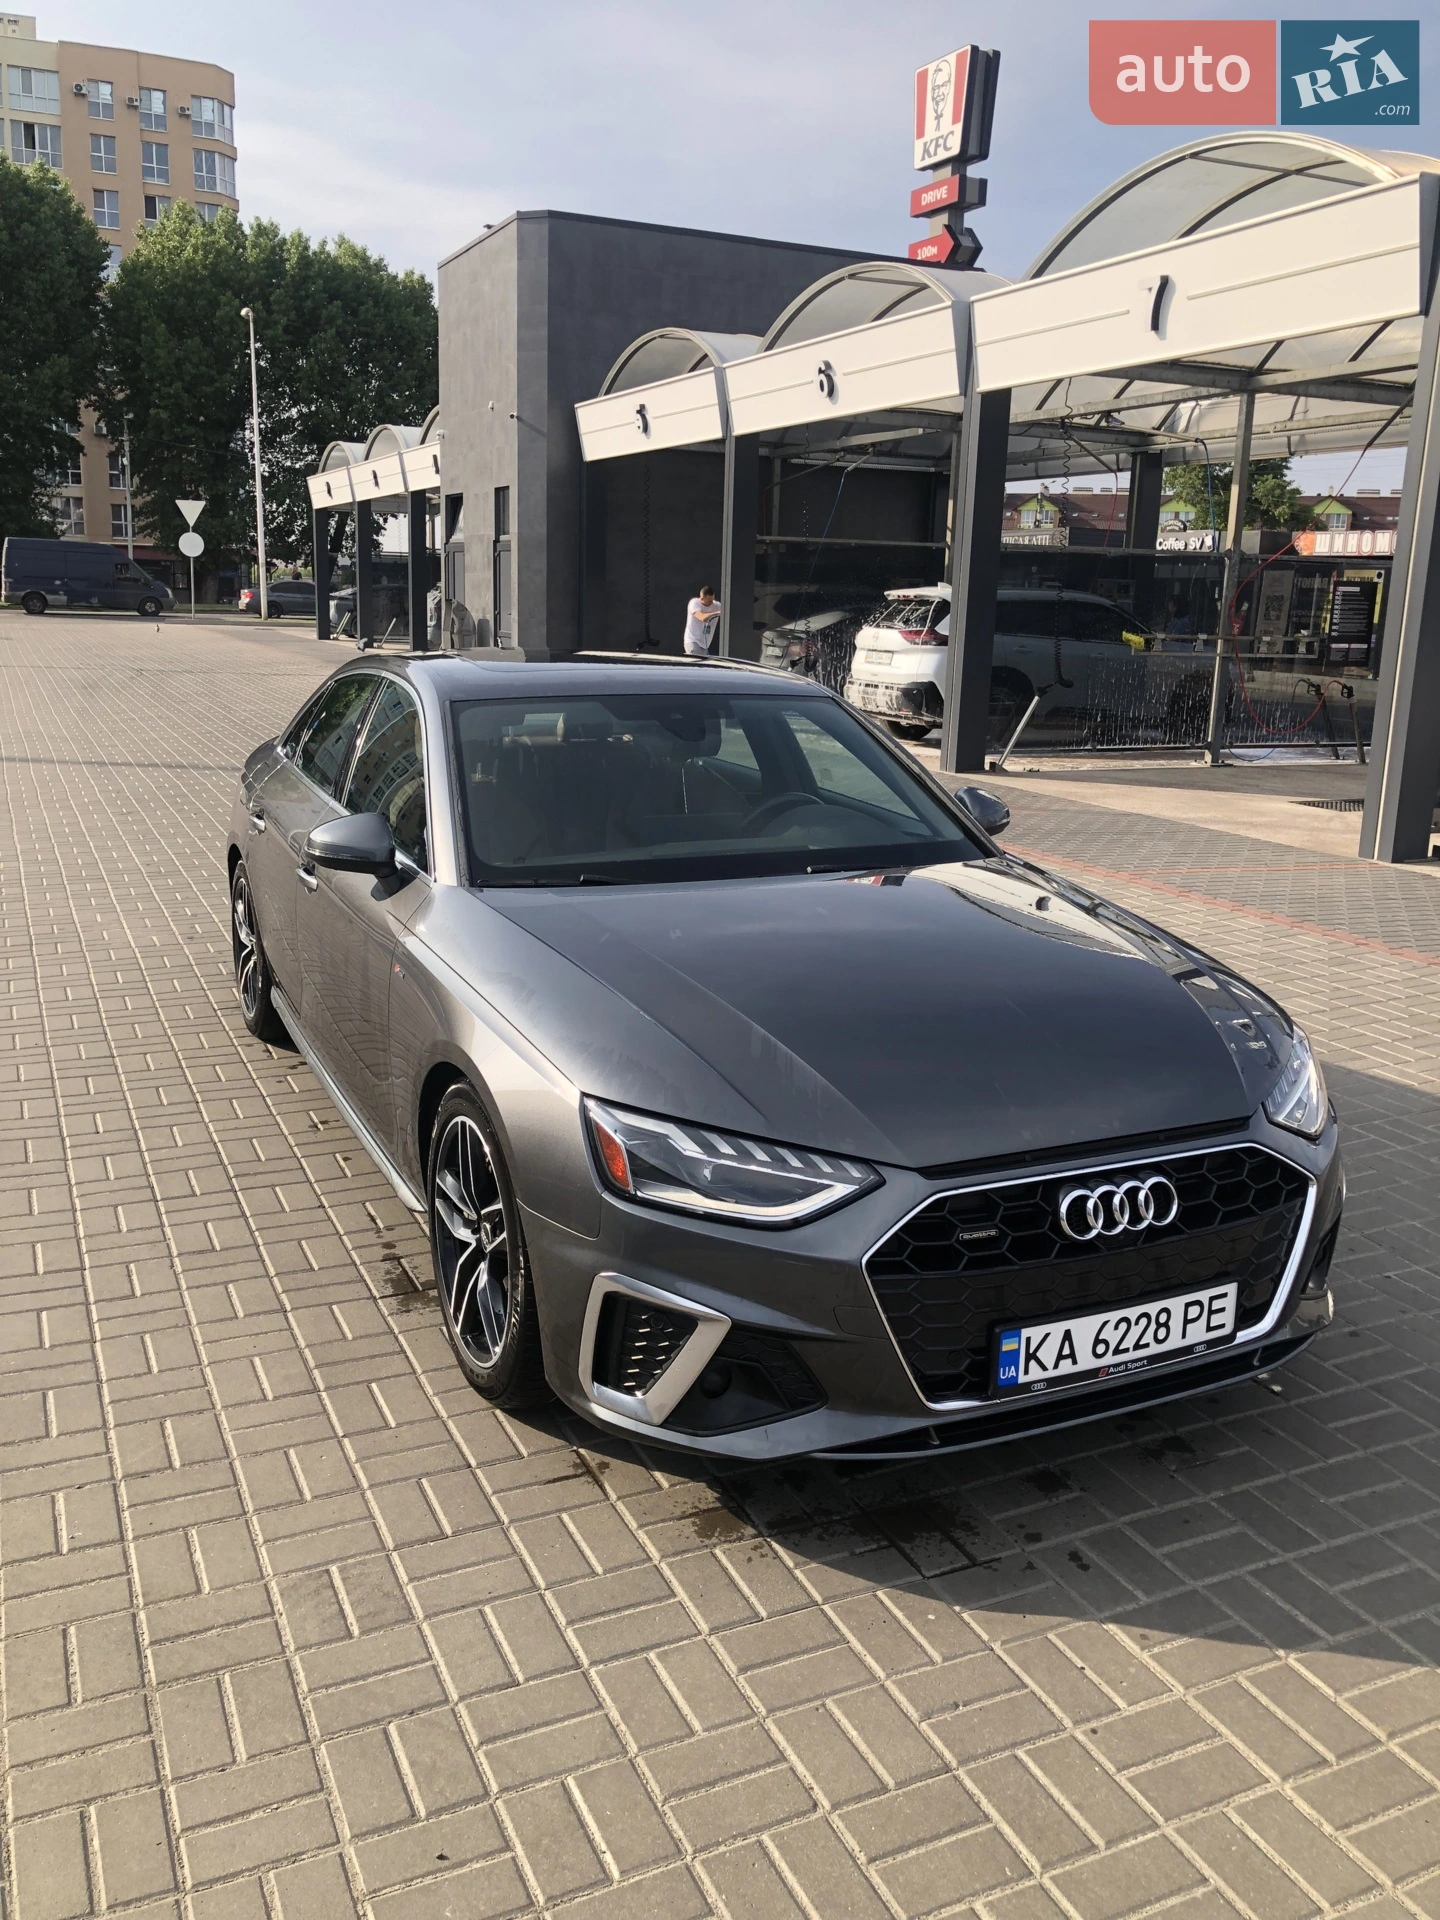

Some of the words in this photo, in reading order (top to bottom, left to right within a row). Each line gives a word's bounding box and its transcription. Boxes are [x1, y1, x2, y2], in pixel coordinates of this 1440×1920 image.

[920, 130, 954, 162] KFC
[921, 185, 949, 206] DRIVE
[1138, 274, 1169, 332] 7
[816, 359, 835, 399] 6
[1156, 537, 1186, 551] Coffee
[1188, 537, 1203, 550] SV
[1023, 1328, 1079, 1376] KA
[1091, 1306, 1172, 1360] 6228
[1181, 1291, 1229, 1340] PE
[1000, 1365, 1017, 1380] UA
[1108, 1362, 1126, 1374] Audi
[1127, 1359, 1148, 1370] Sport
